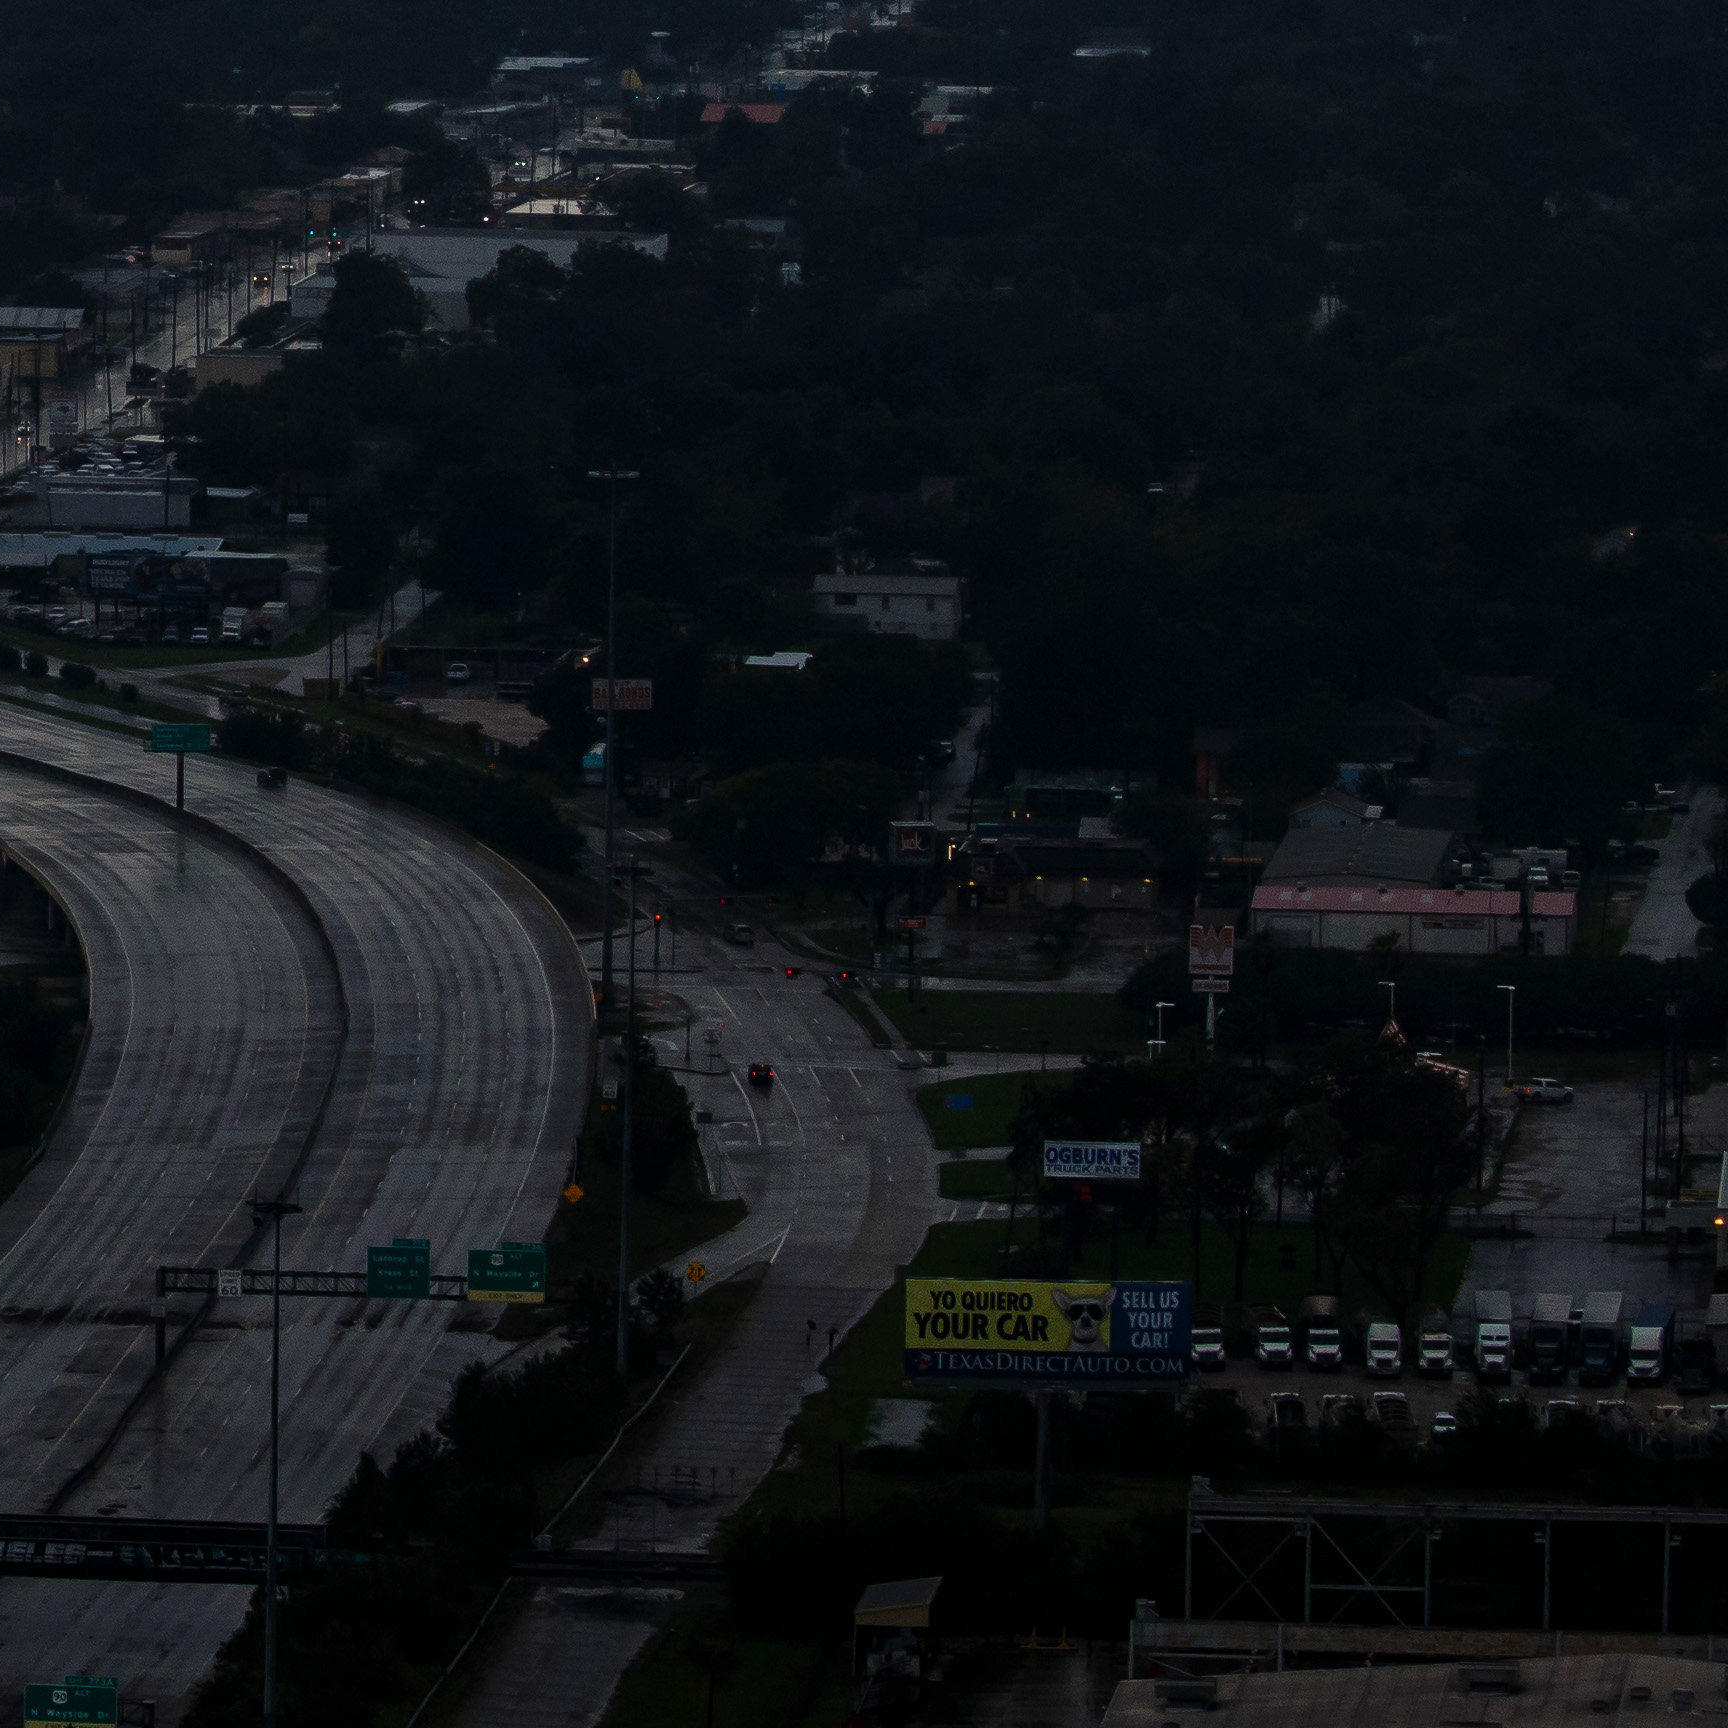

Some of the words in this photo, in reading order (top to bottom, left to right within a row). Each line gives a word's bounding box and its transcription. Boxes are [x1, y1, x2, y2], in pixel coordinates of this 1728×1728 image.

[1046, 1147, 1139, 1166] OGBURN'S
[1046, 1164, 1091, 1173] TRUCK
[1095, 1165, 1138, 1175] PARTS
[221, 1286, 238, 1295] 60
[931, 1291, 956, 1309] YO
[962, 1291, 1032, 1311] QUIERO
[1122, 1291, 1155, 1309] SELL
[1160, 1291, 1180, 1309] US
[914, 1313, 989, 1339] YOUR
[997, 1314, 1048, 1341] CAR
[1128, 1311, 1173, 1329] YOUR
[1131, 1332, 1169, 1349] CAR!
[54, 1692, 67, 1701] 90
[74, 1689, 90, 1697] ALT
[31, 1707, 38, 1716] N
[47, 1709, 89, 1719] Wayside
[97, 1711, 109, 1719] Dr
